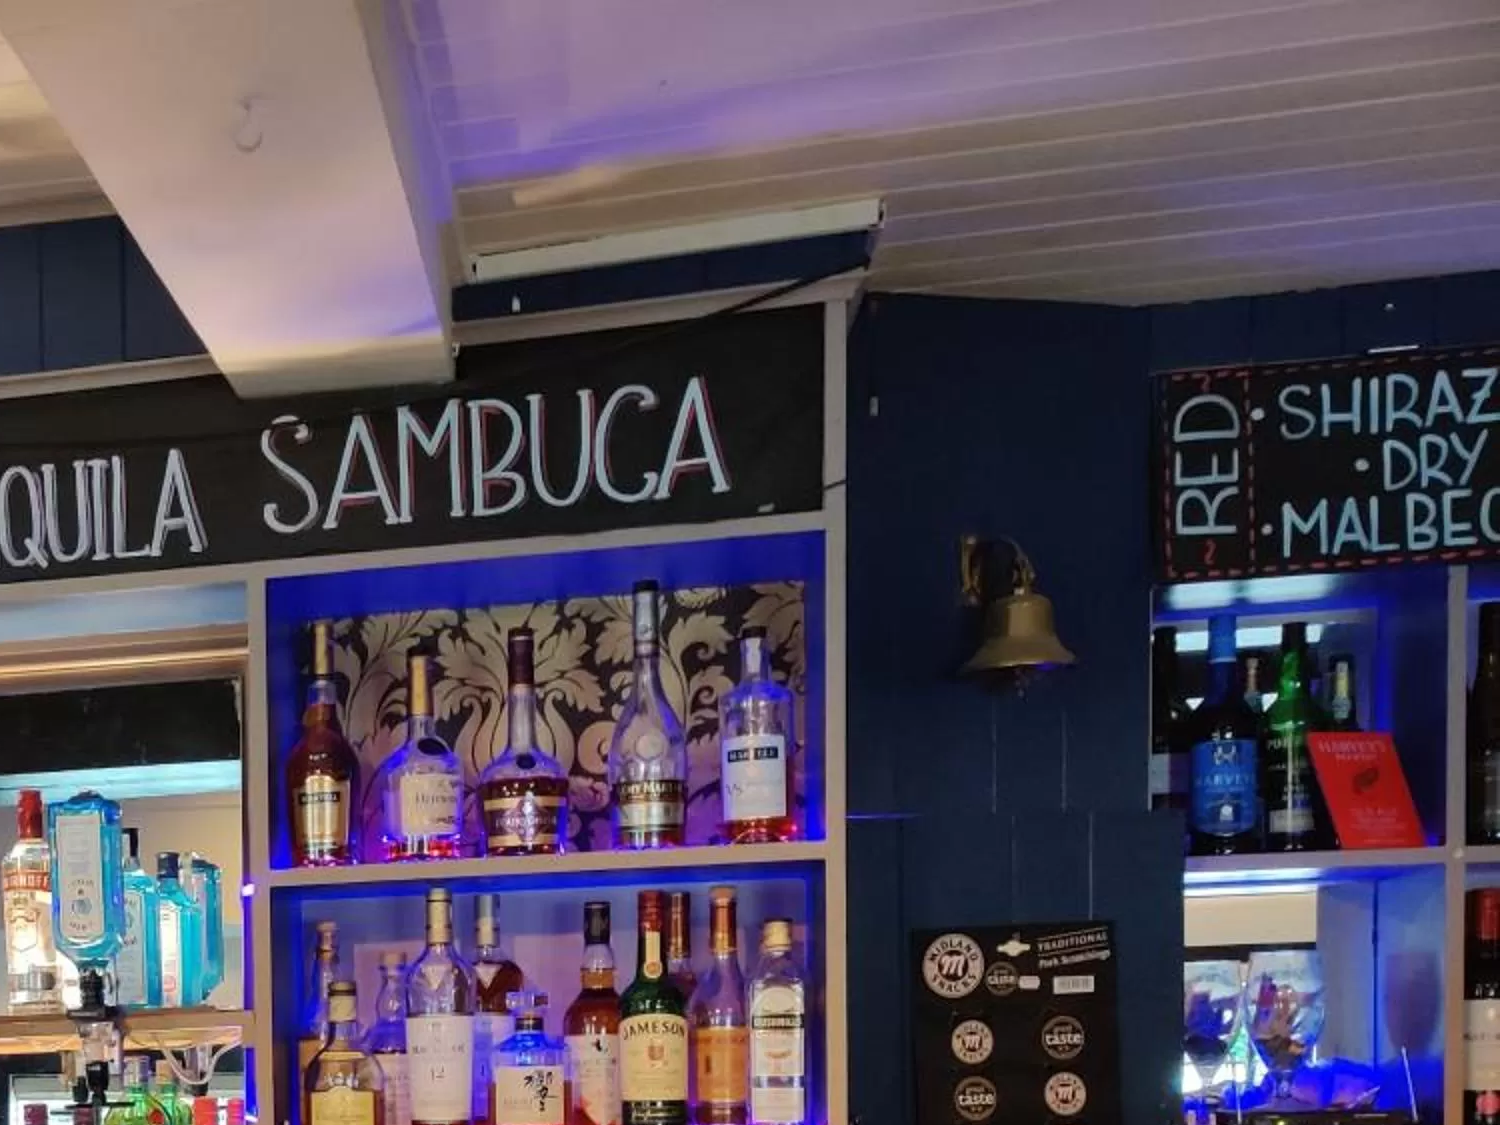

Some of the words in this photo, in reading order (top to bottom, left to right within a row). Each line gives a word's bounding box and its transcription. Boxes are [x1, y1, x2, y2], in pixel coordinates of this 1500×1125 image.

[262, 377, 732, 533] SAMBUCA
[1173, 393, 1240, 536] RED
[1383, 428, 1488, 491] DRY
[622, 1020, 685, 1041] JAMESON
